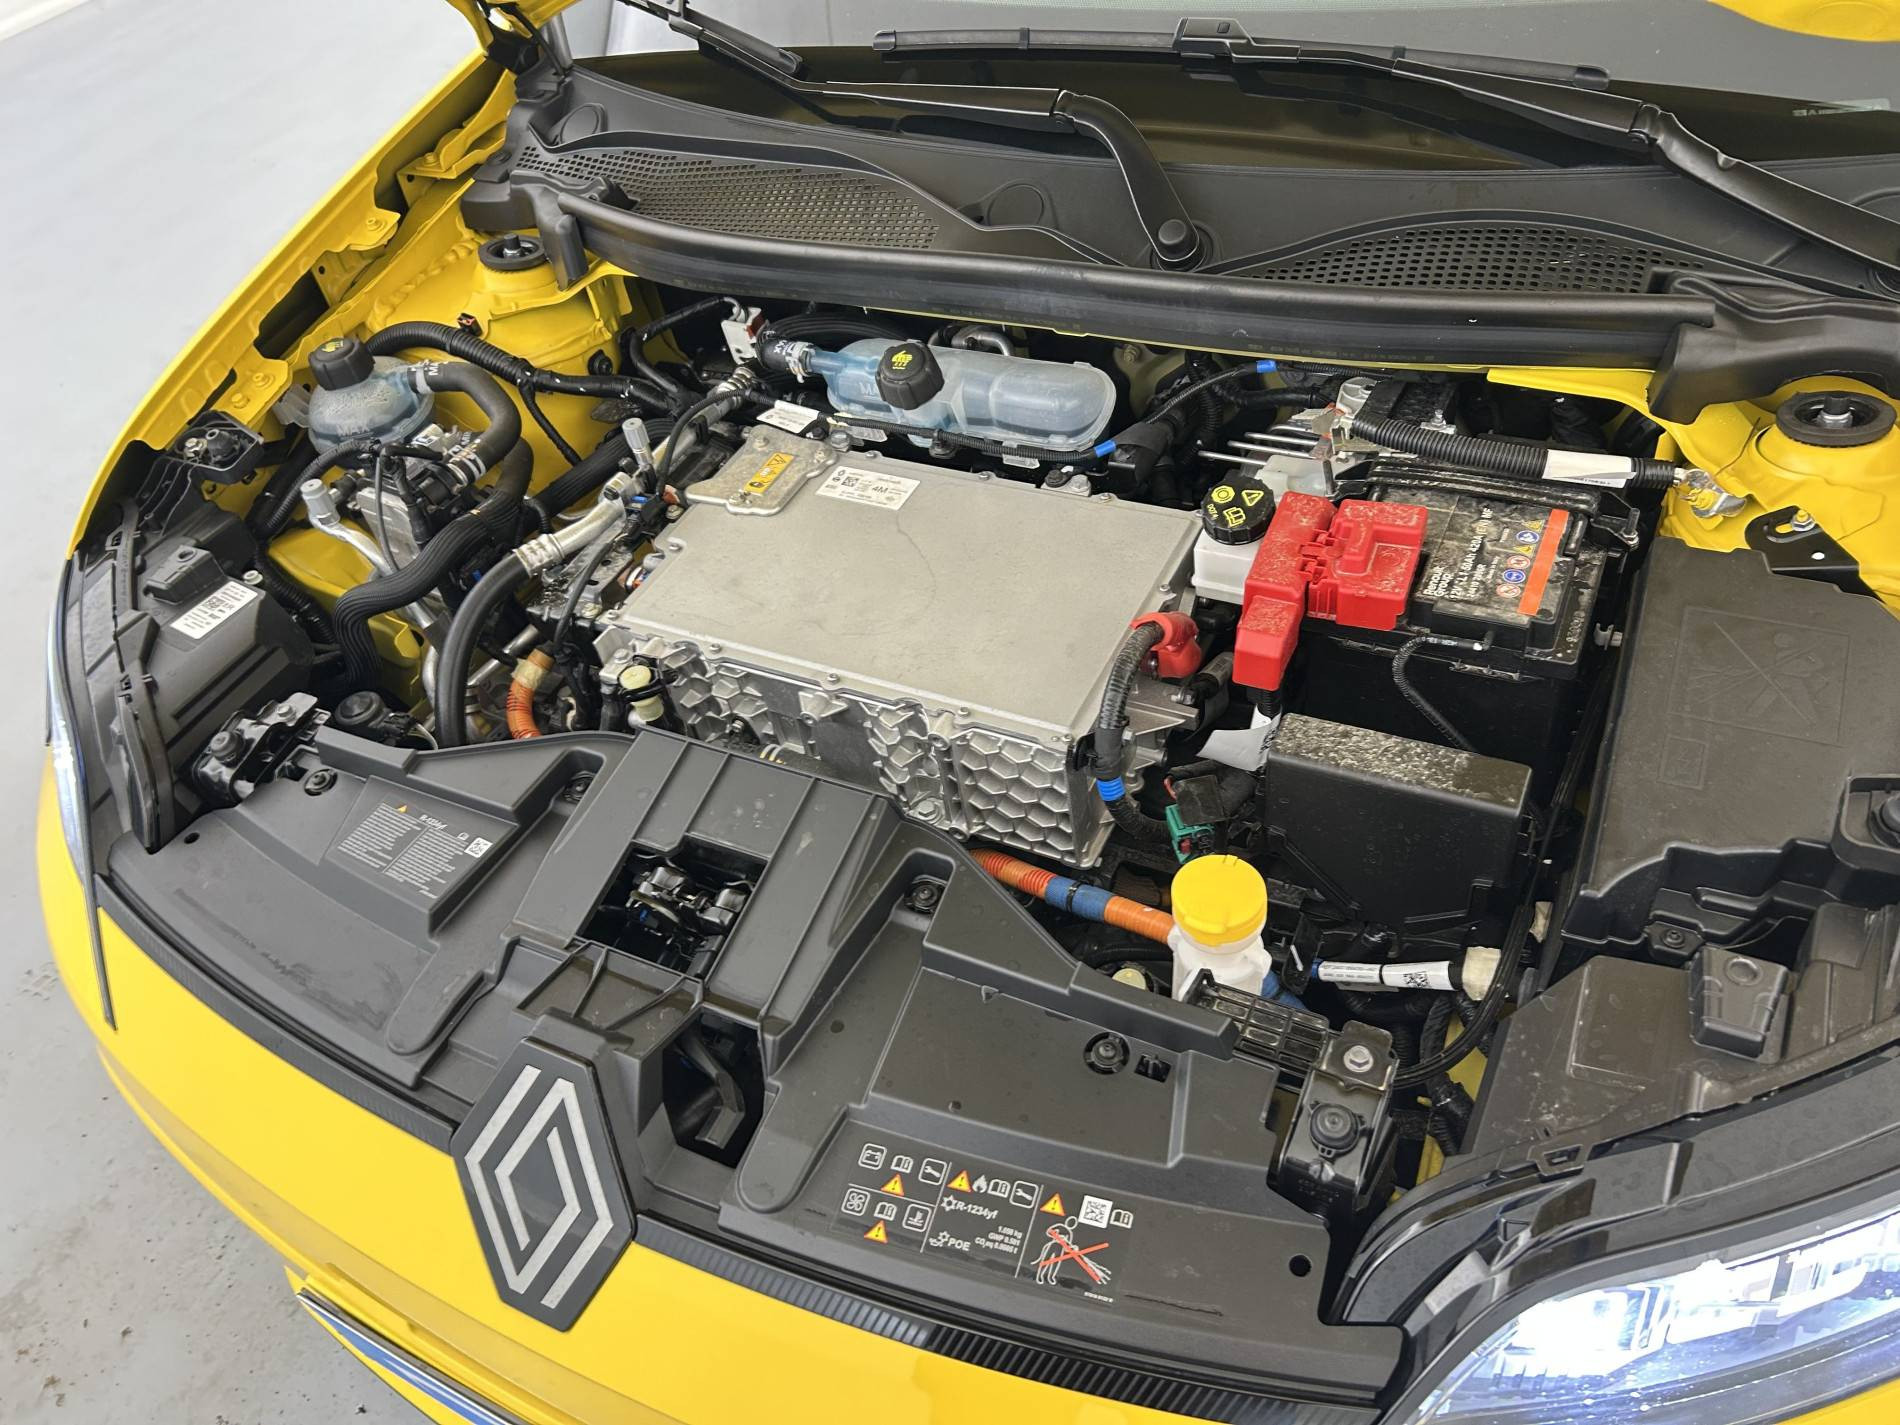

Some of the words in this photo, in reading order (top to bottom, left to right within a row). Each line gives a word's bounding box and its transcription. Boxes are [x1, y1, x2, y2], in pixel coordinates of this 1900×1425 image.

[1469, 535, 1483, 552] 420A
[1422, 565, 1443, 596] Renault
[1434, 573, 1452, 597] Group
[956, 1201, 999, 1220] R-1234yf
[947, 1237, 971, 1251] POE
